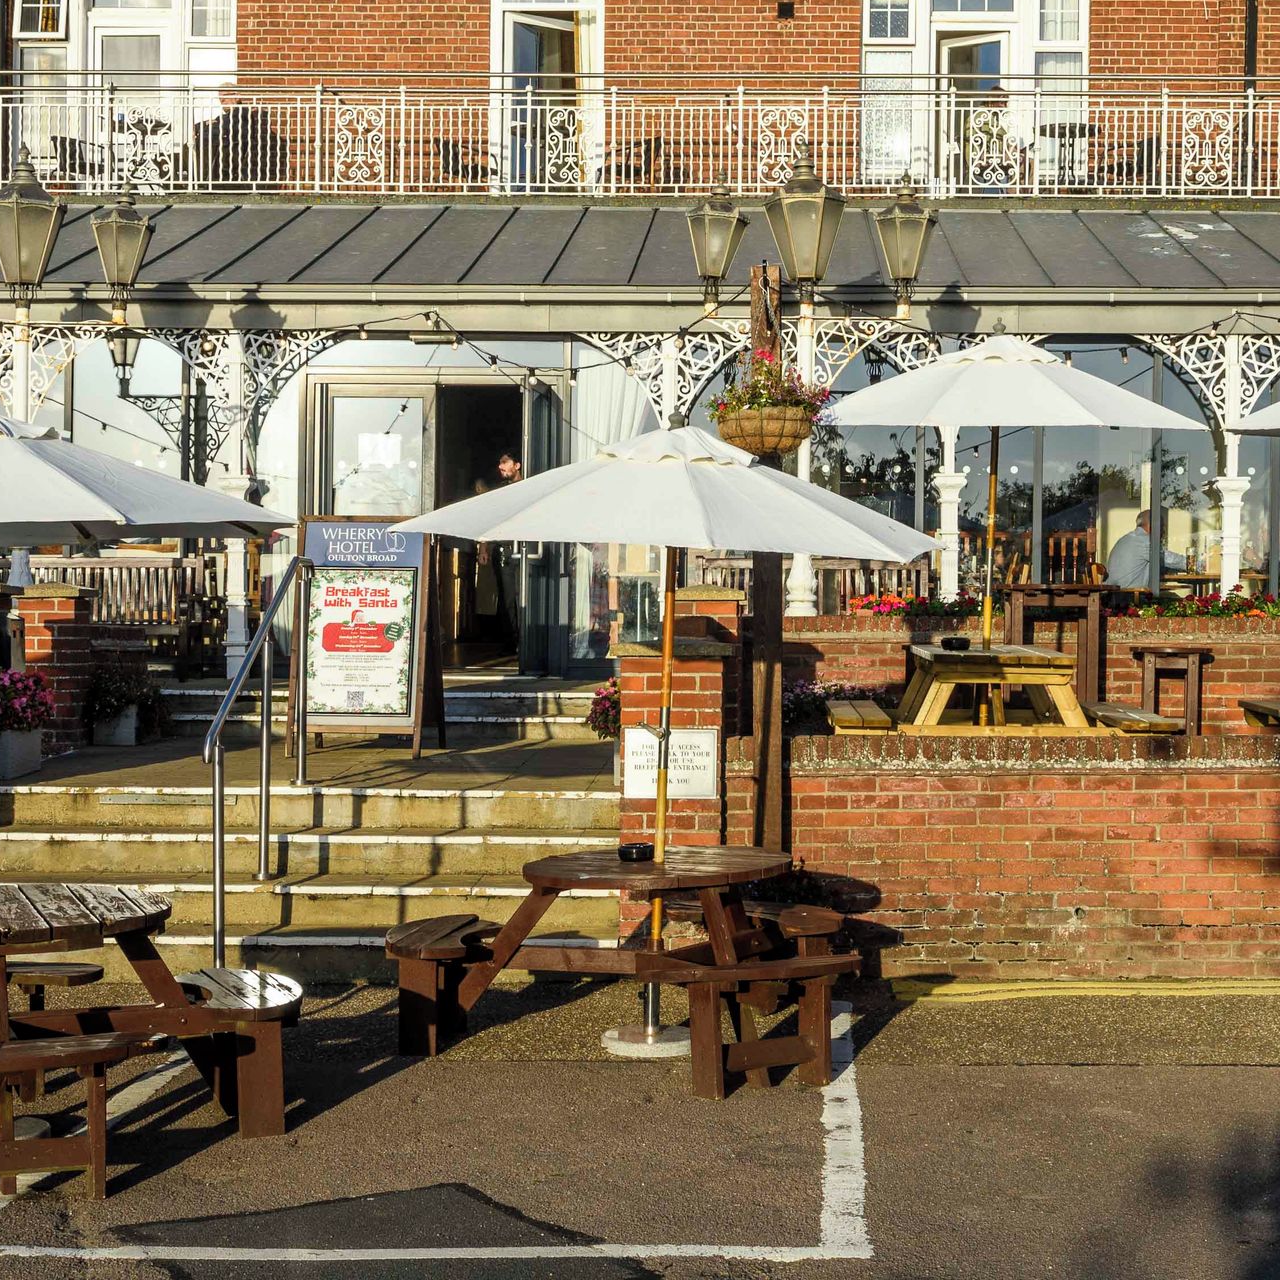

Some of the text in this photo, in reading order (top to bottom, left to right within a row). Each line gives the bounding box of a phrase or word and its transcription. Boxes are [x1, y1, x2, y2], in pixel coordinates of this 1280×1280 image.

[322, 527, 385, 540] WHERRY
[329, 541, 377, 554] HOTEL
[328, 554, 397, 562] OULTON BROAD
[324, 597, 398, 608] with Santa
